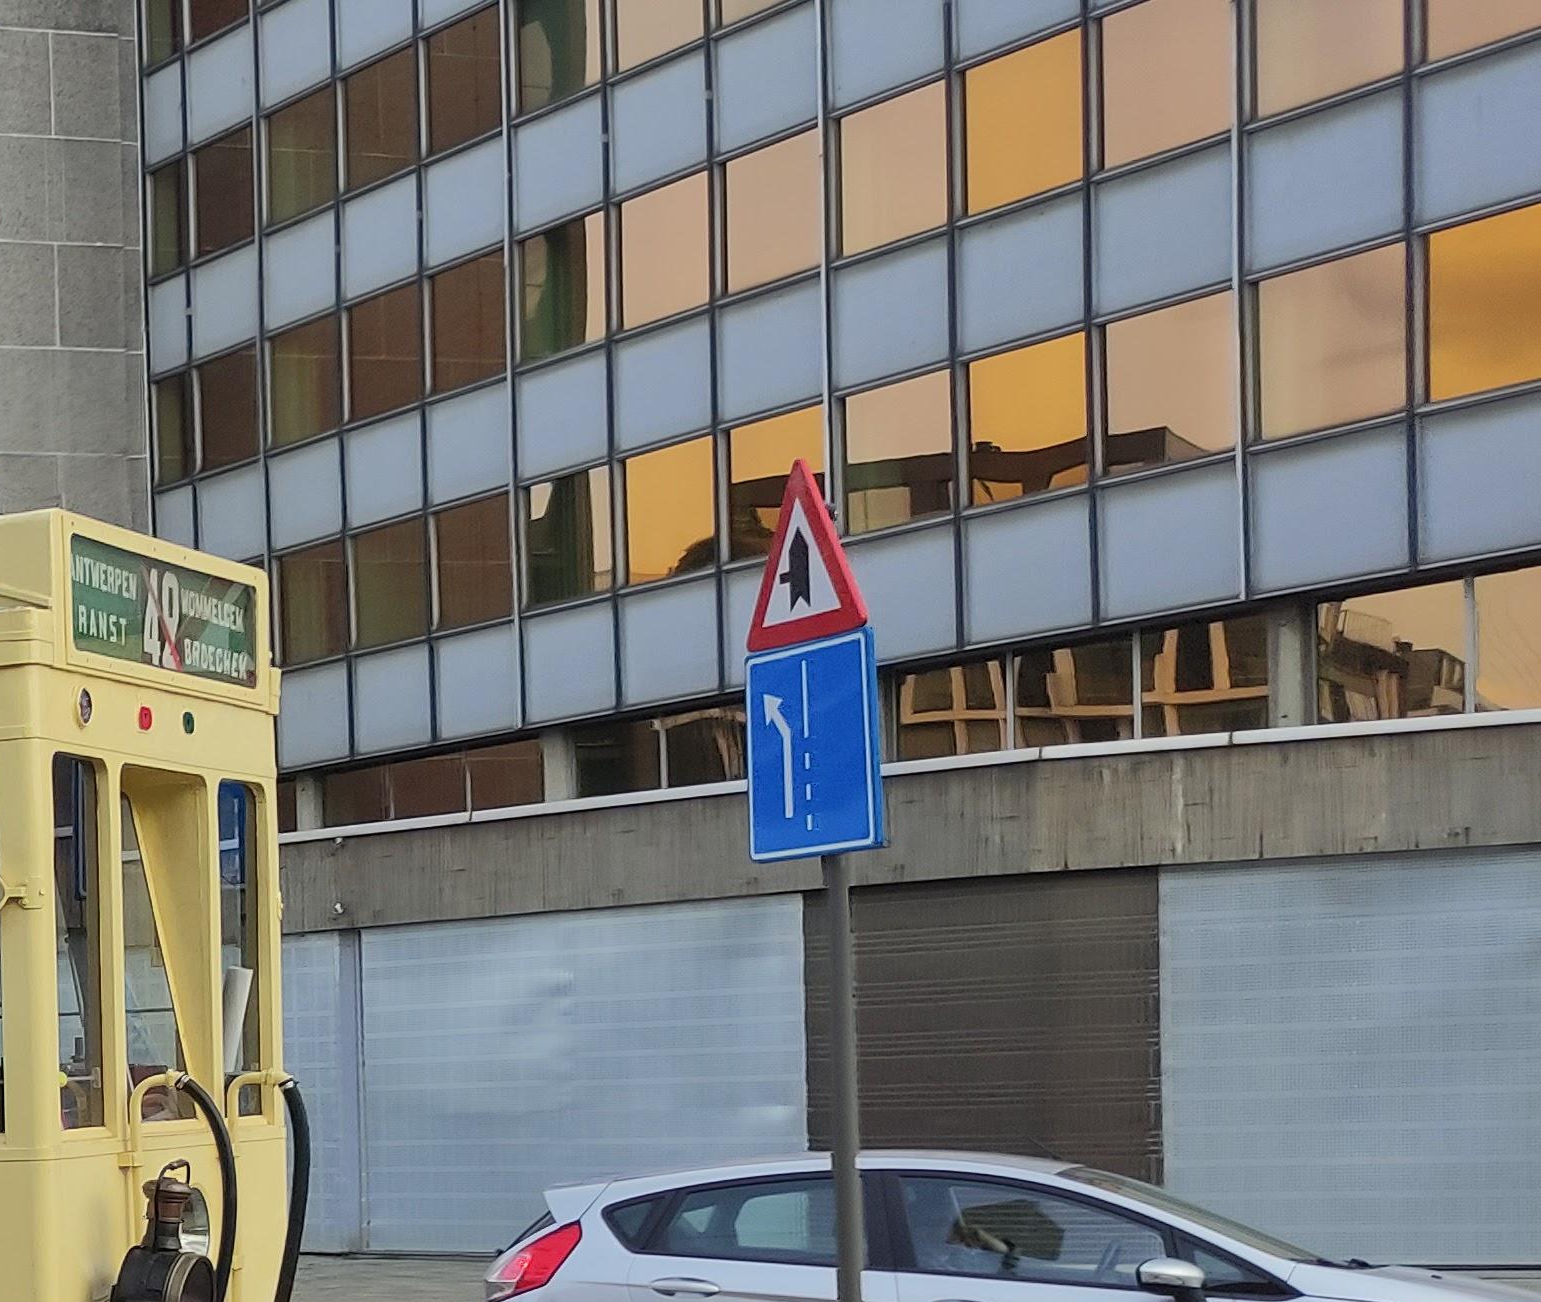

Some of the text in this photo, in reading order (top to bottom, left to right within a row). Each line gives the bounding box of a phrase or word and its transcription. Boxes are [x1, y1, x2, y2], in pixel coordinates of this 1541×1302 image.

[71, 555, 138, 601] ANTWERPEN
[78, 605, 127, 647] RANST
[184, 639, 247, 680] BROECHEM
